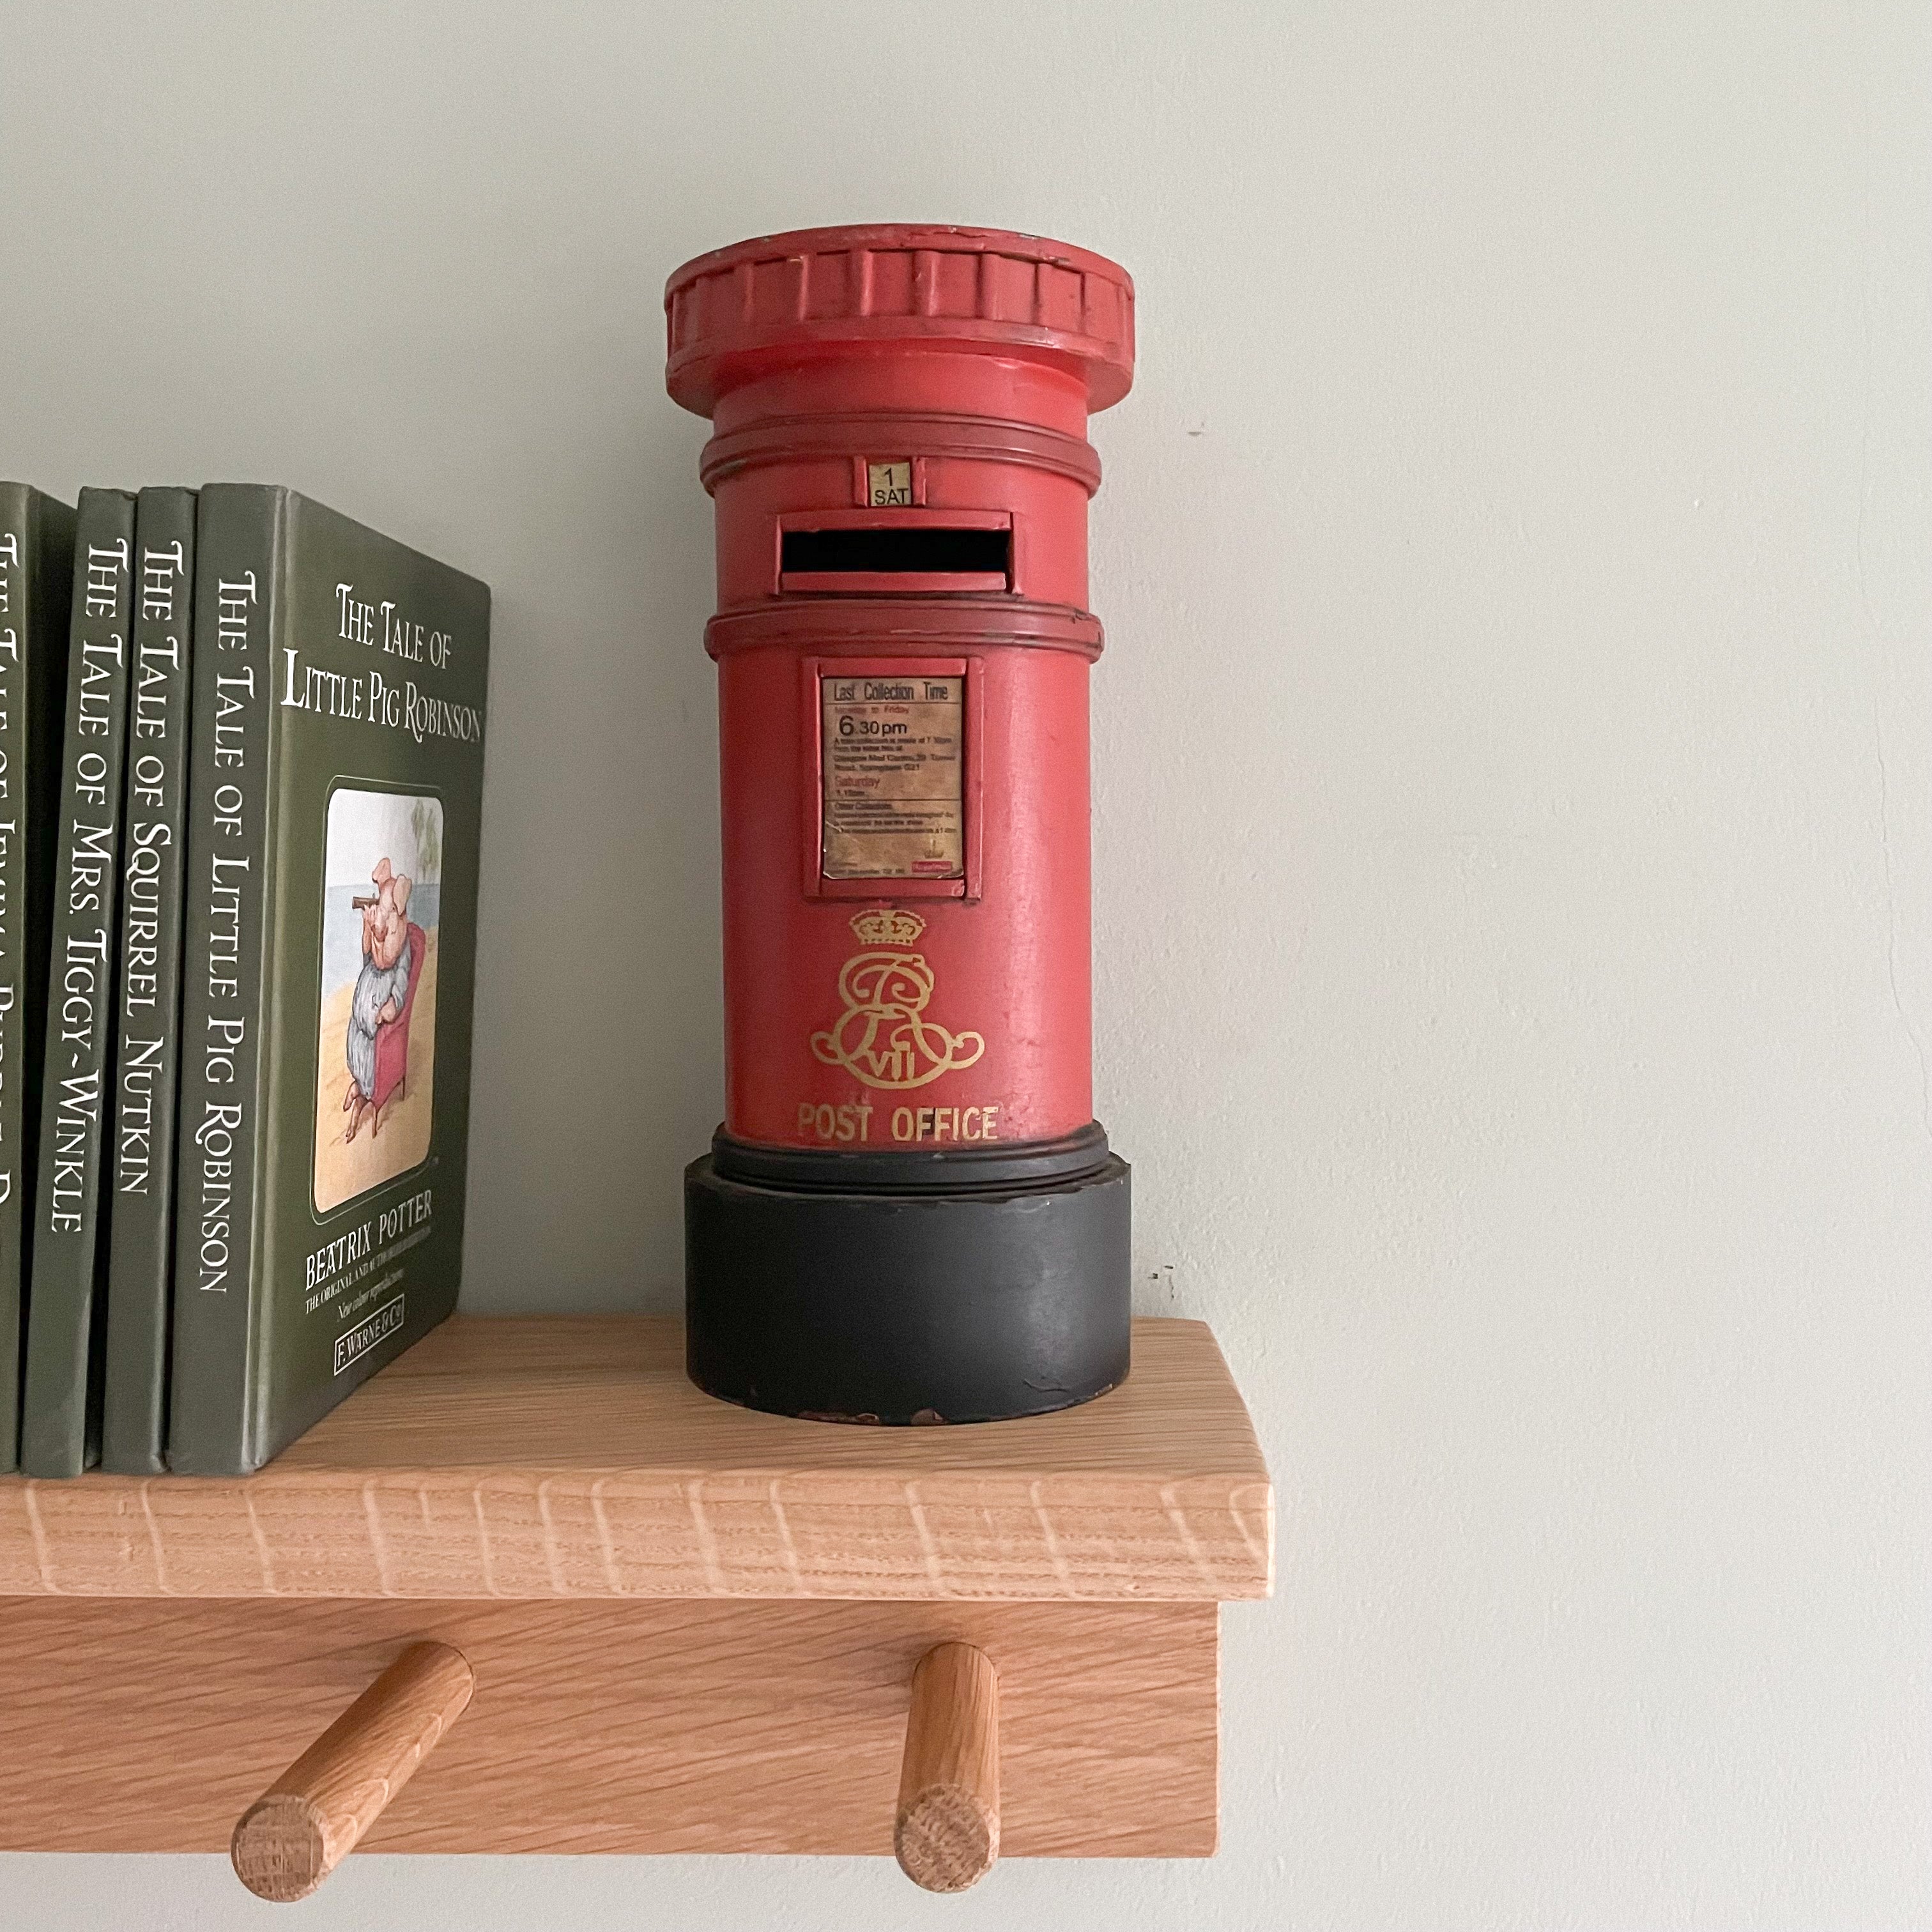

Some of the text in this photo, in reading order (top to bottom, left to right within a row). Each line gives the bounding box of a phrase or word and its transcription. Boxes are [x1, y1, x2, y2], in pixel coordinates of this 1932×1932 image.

[875, 489, 909, 505] SAT
[884, 468, 893, 487] 1
[86, 539, 128, 617] THE
[336, 583, 451, 669] THE TALE OF
[79, 634, 123, 735] TALE
[280, 648, 481, 743] LITTLE PIG ROBINSON
[834, 682, 949, 701] Last Collection Time
[75, 753, 106, 804] OF
[835, 776, 880, 788] Saturday
[70, 819, 113, 914] MRS.
[120, 541, 184, 1195] THE TALE OF SQUIRREL NUTKIN
[195, 571, 257, 1292] THE TALE OF LITTLE PIG ROBINSON
[798, 1103, 999, 1142] POST OFFICE
[305, 1221, 372, 1291] BEATRIX
[378, 1190, 433, 1245] POTTER
[305, 1292, 320, 1314] THE
[347, 1319, 380, 1357] WARNE
